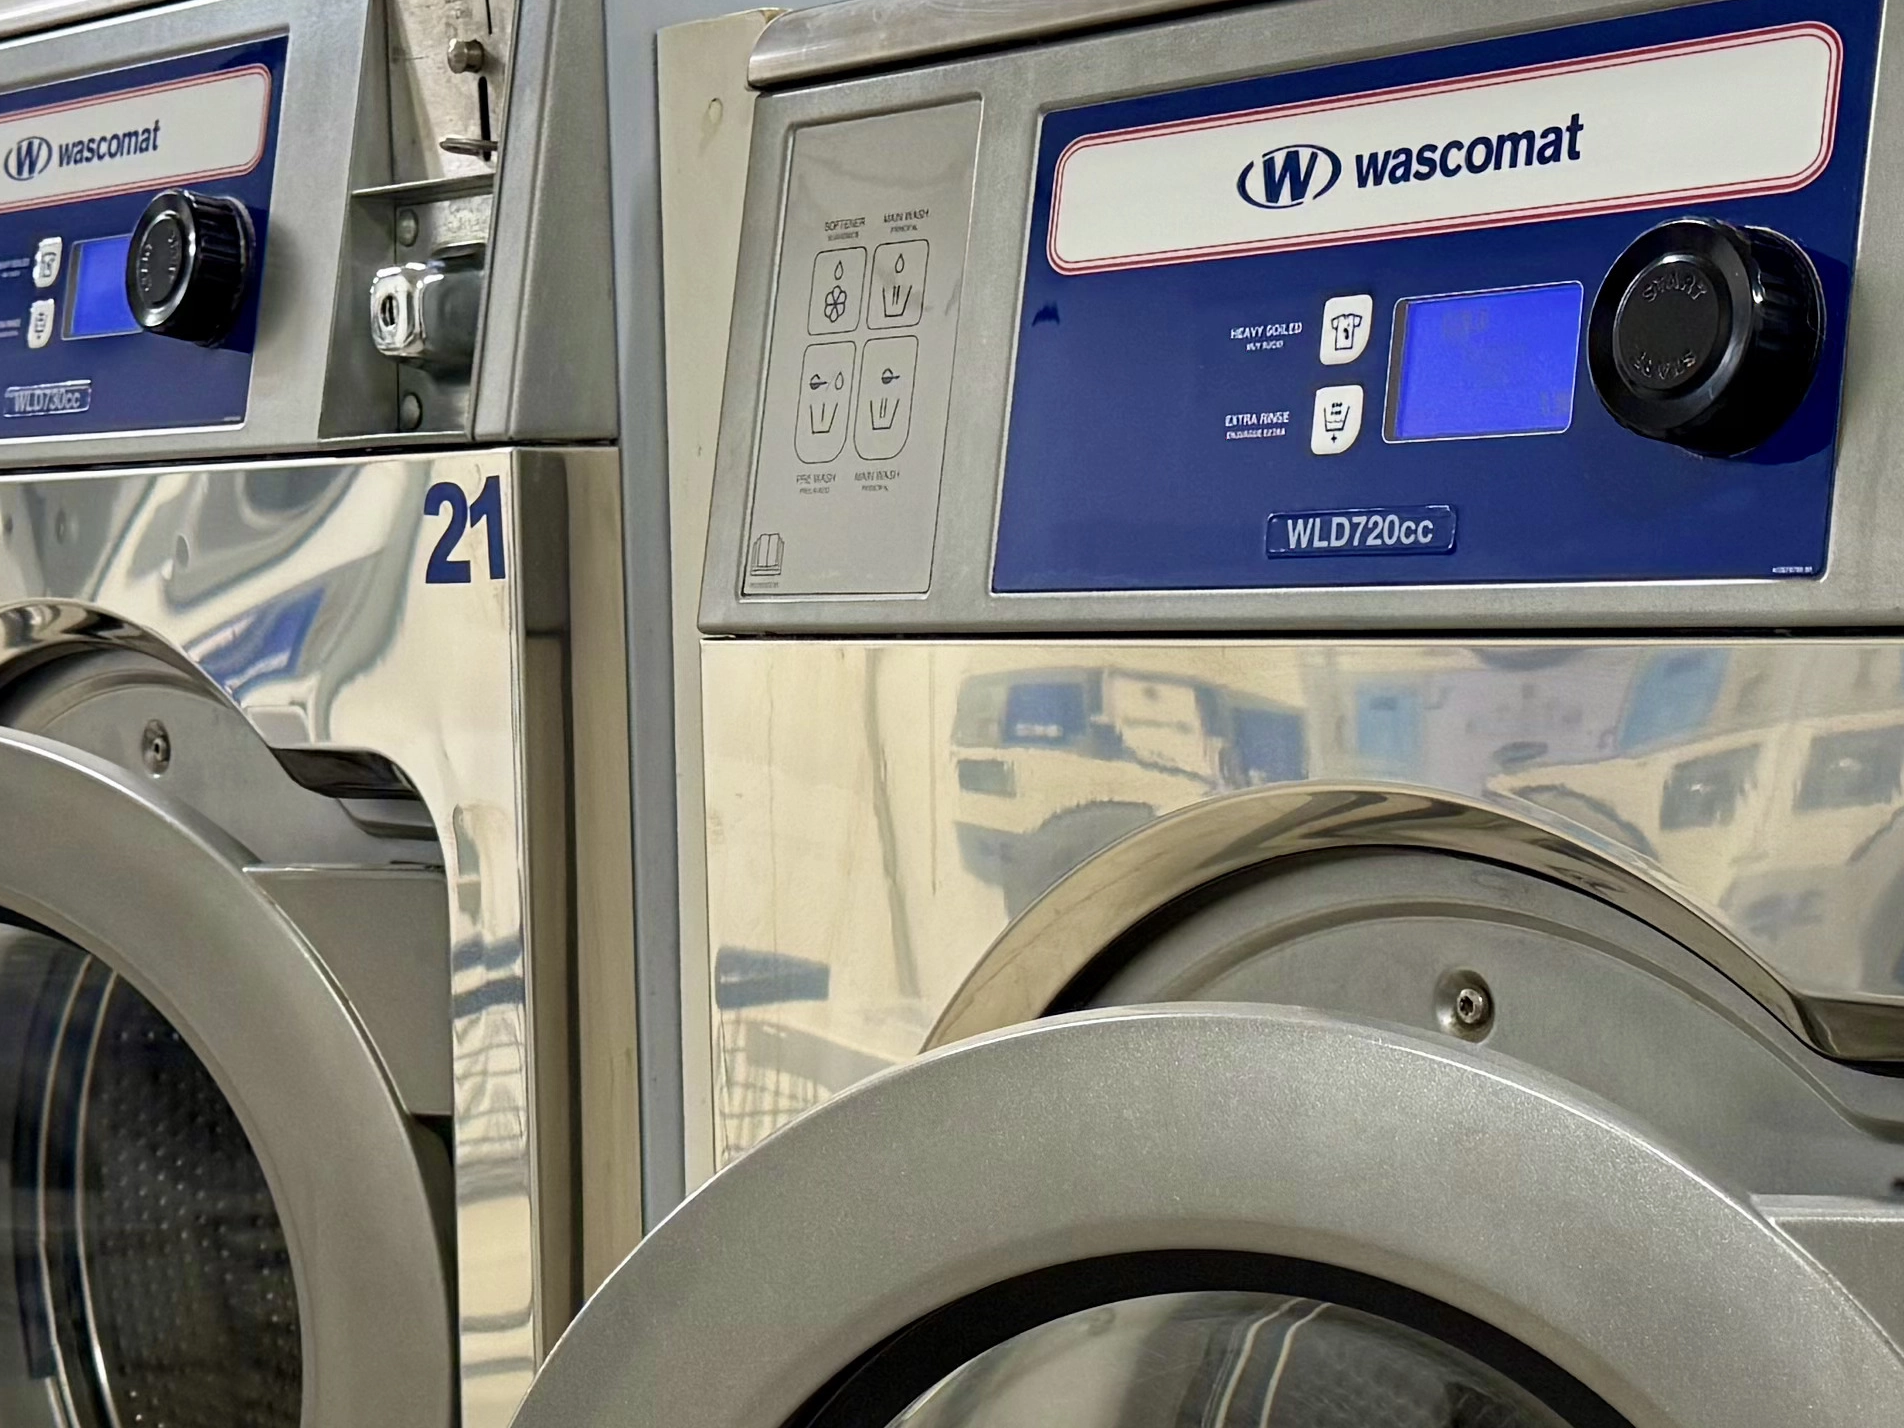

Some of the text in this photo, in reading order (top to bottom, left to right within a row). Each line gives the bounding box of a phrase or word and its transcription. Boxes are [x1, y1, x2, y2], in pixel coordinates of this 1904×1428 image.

[58, 118, 161, 168] wascomat
[1355, 113, 1584, 189] wascomat
[14, 390, 81, 413] WLD730cc
[1224, 411, 1291, 427] EXTRA RINSE
[423, 474, 506, 584] 21
[1287, 514, 1434, 549] WLD720cc
